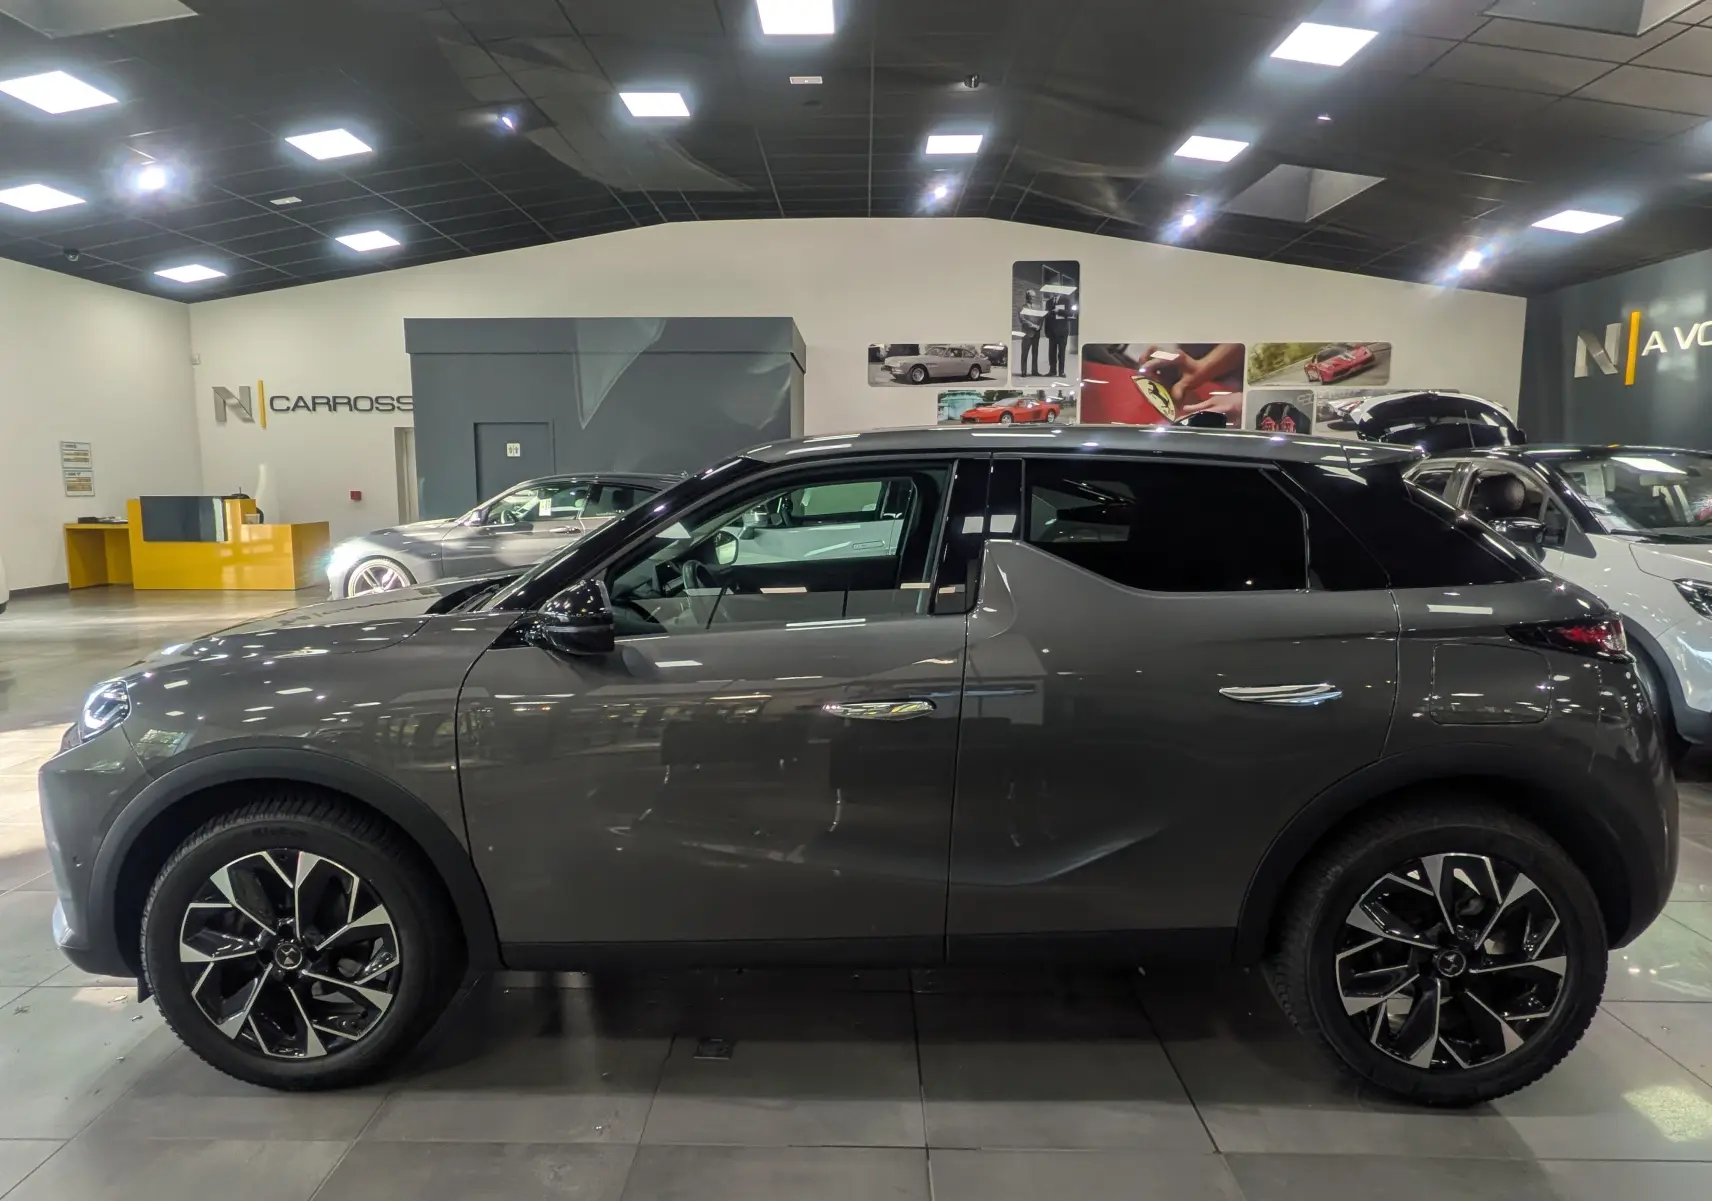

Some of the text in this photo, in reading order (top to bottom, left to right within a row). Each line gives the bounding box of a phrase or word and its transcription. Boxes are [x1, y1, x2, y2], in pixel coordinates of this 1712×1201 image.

[1574, 323, 1621, 378] N
[1641, 330, 1668, 356] A
[212, 386, 414, 423] N CARROSS
